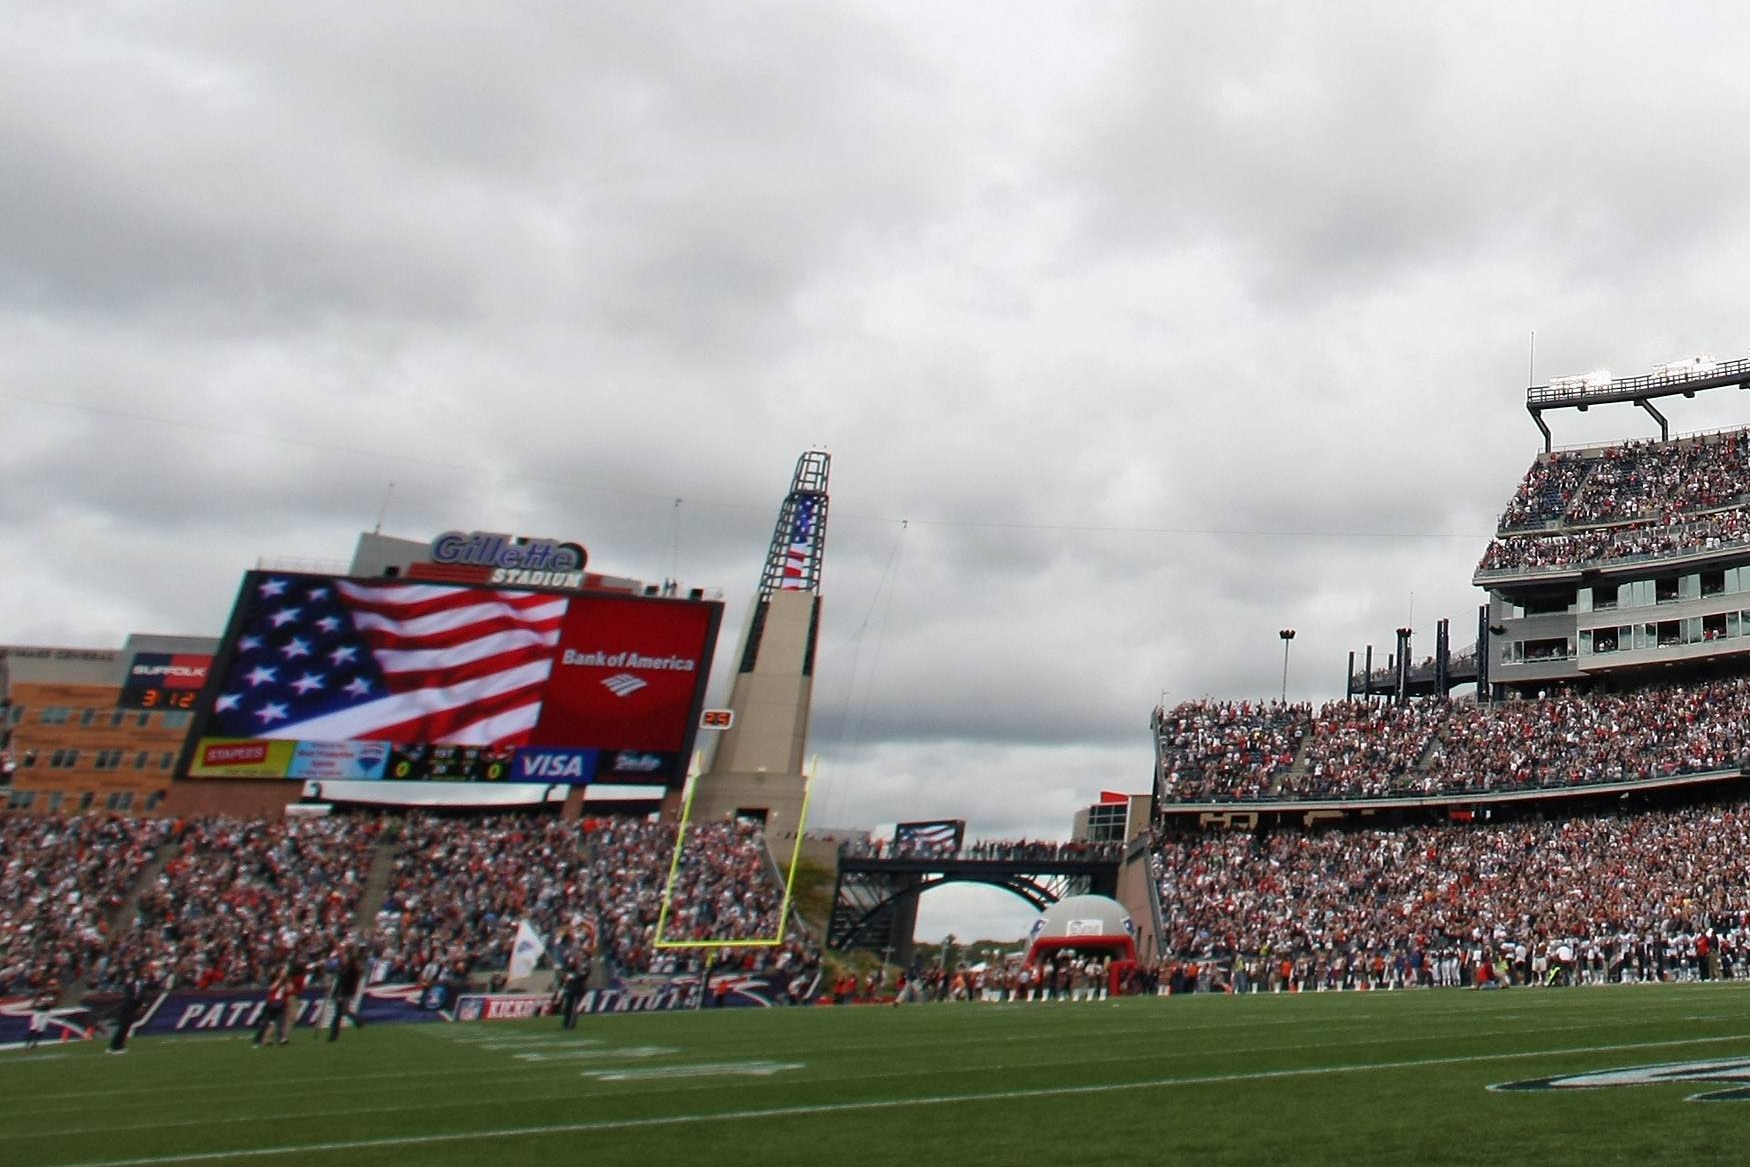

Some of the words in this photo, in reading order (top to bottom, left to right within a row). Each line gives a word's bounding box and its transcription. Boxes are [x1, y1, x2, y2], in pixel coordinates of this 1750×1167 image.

[433, 533, 578, 571] Gillette
[491, 568, 582, 588] STADIUM
[562, 649, 606, 666] Bank
[607, 652, 627, 668] of
[625, 653, 695, 671] America
[396, 761, 411, 778] 0
[487, 762, 502, 780] 0
[523, 754, 583, 777] VISA
[575, 984, 702, 1014] ATRIOTS
